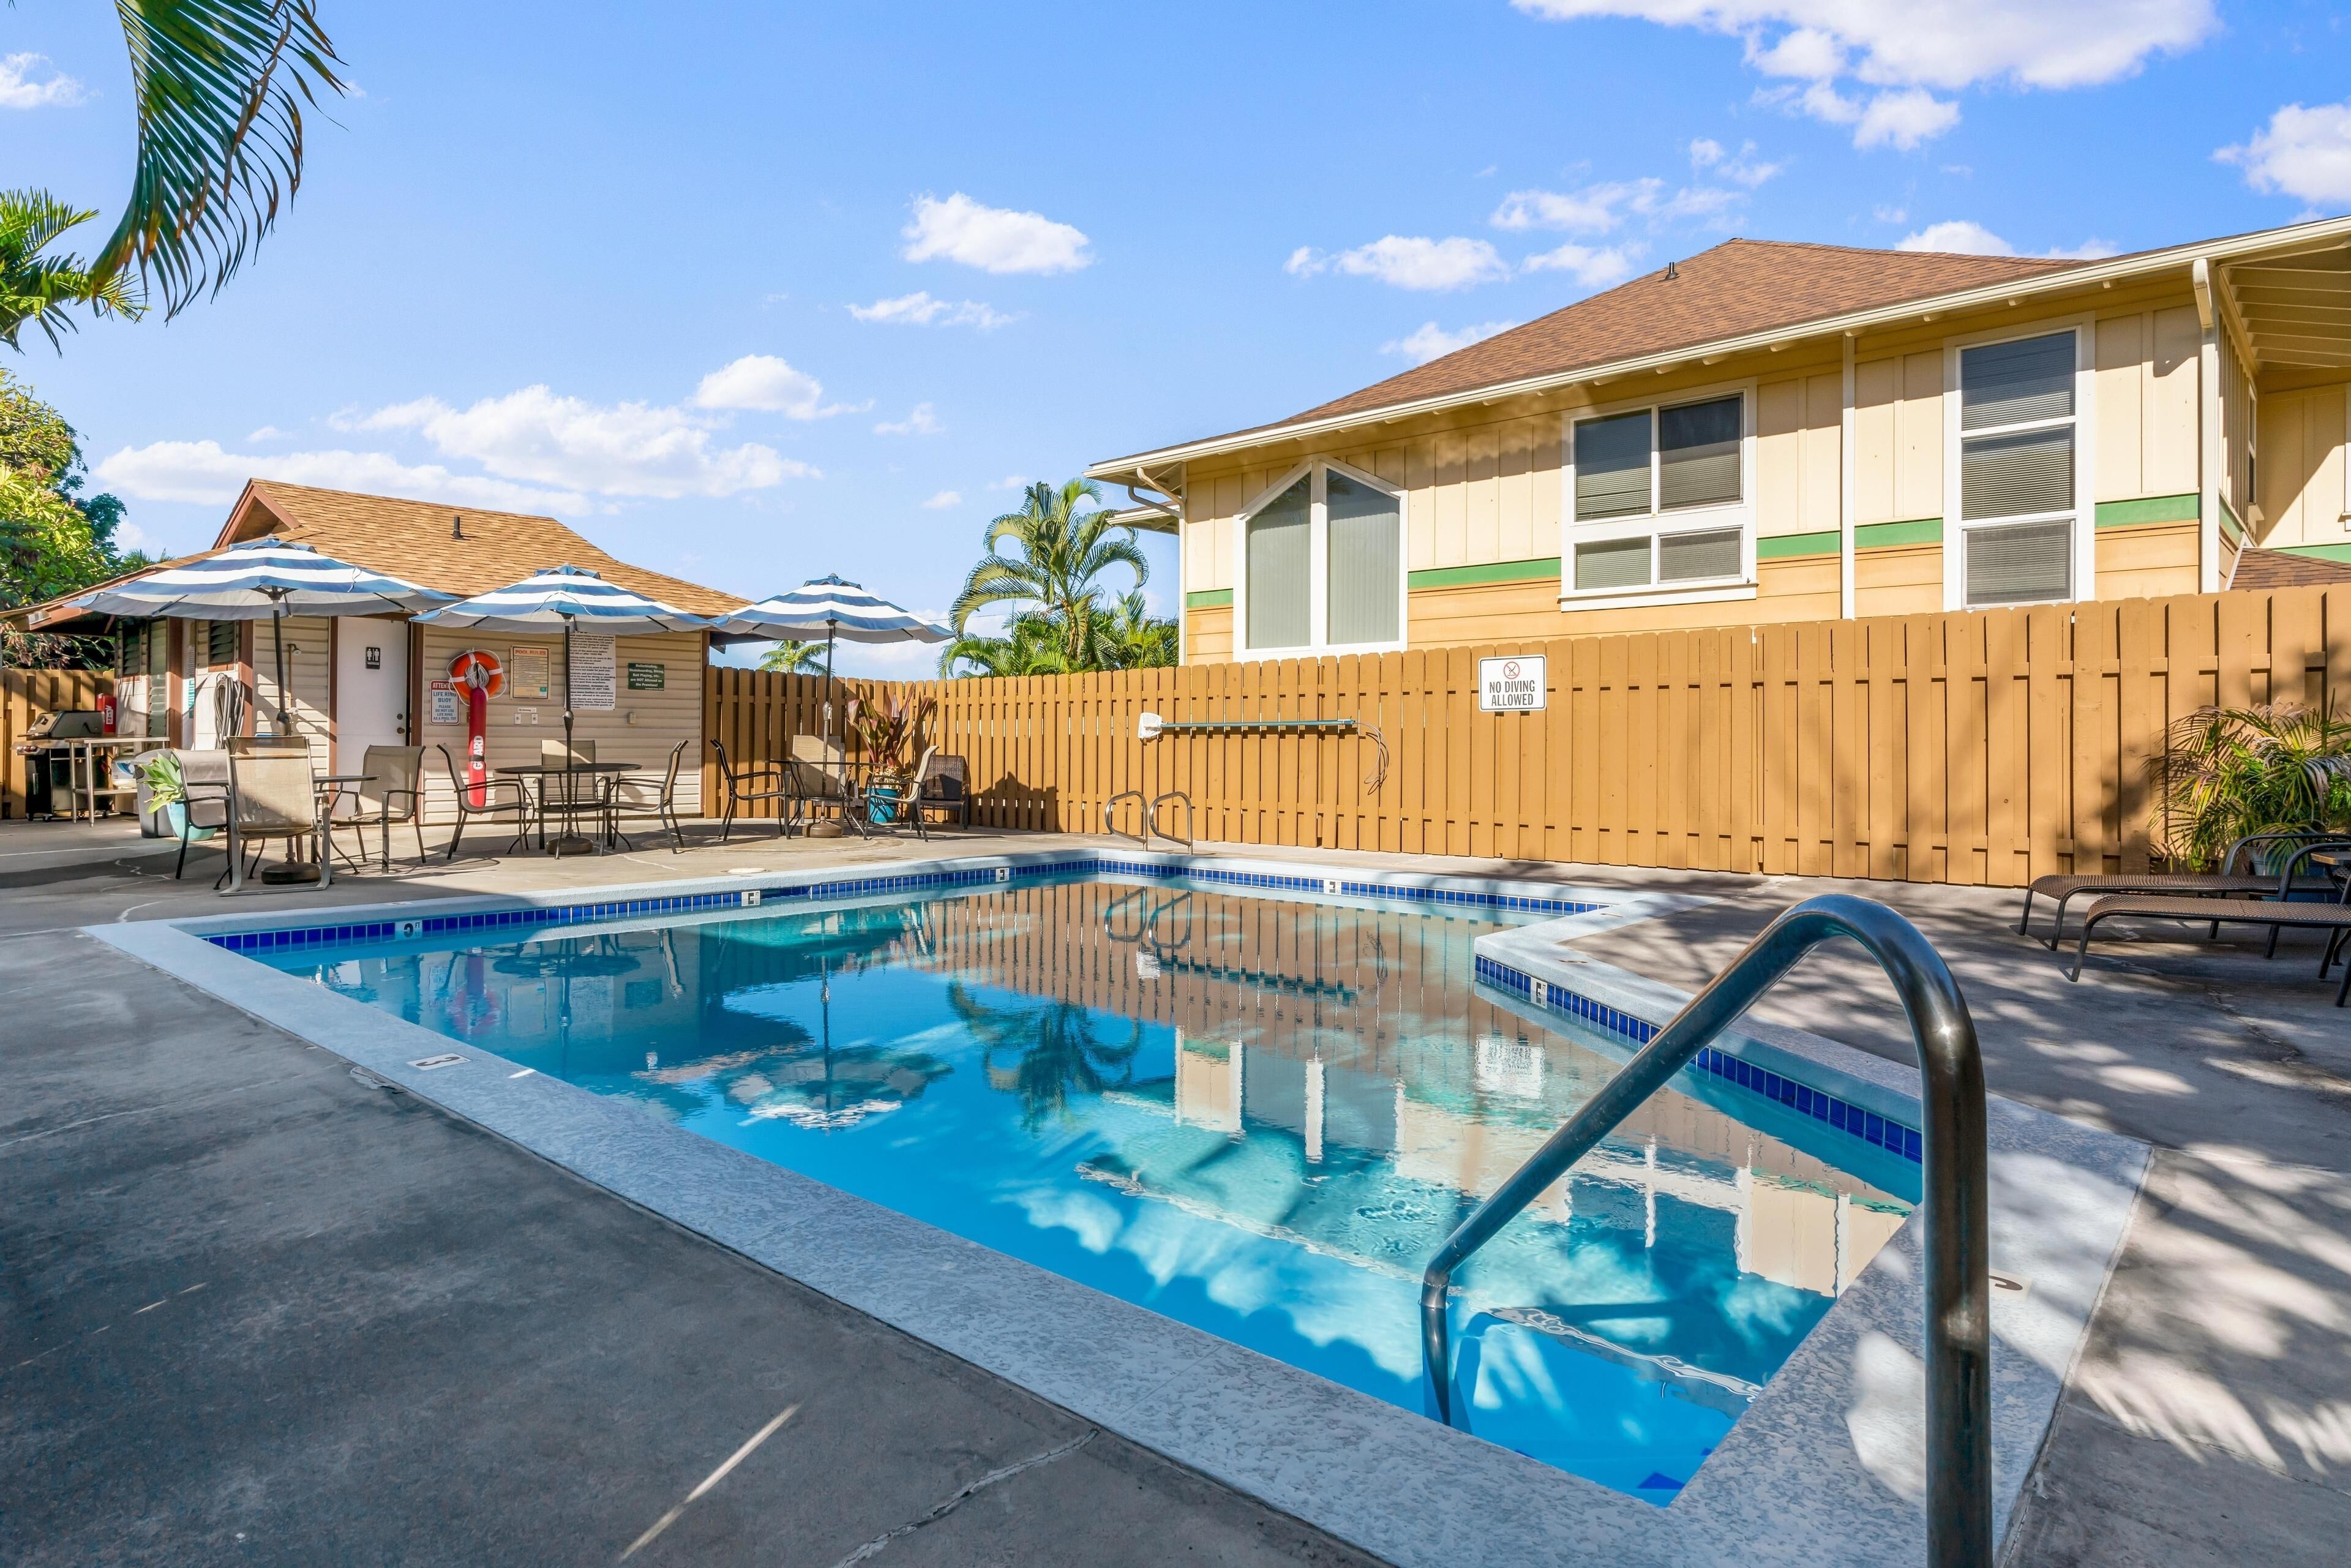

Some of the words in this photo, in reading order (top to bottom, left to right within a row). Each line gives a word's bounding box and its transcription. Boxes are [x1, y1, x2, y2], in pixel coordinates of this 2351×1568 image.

[1490, 681, 1501, 693] NO
[1505, 680, 1535, 692] DIVING
[1491, 694, 1534, 706] ALLOWED
[473, 736, 483, 770] GARD
